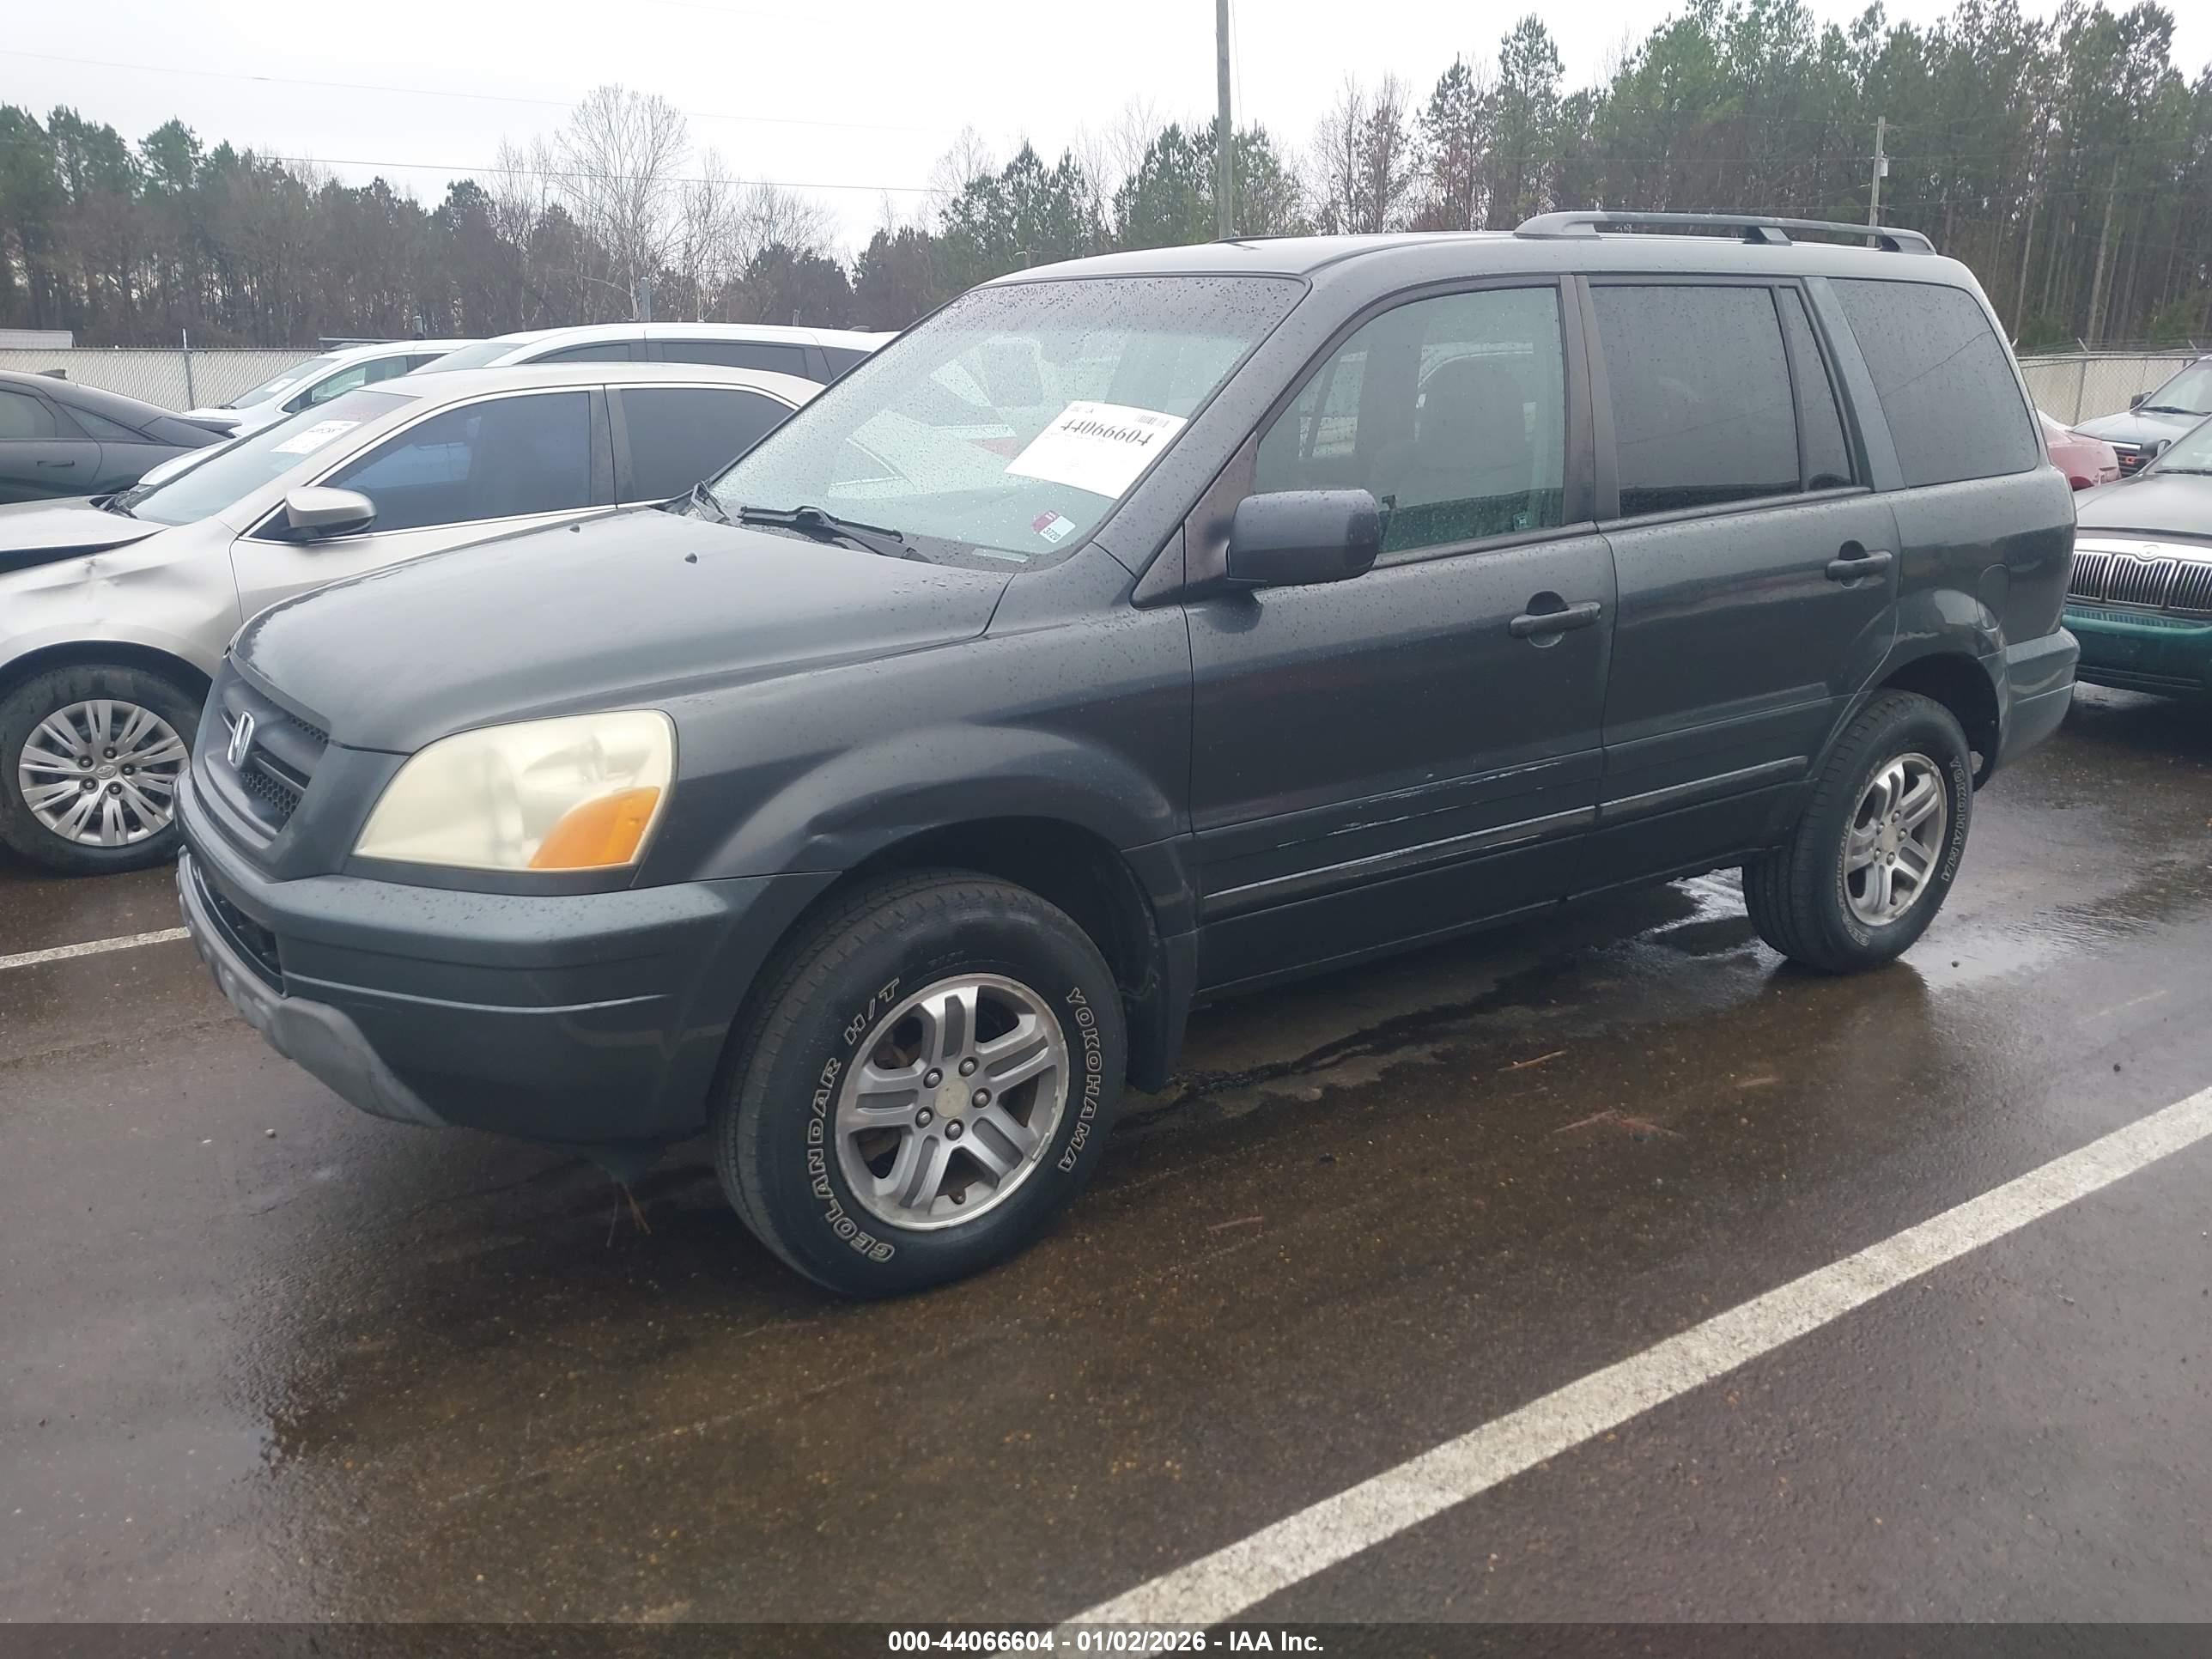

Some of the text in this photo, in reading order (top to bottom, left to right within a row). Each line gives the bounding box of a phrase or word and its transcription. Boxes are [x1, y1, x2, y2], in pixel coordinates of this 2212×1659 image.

[1060, 418, 1154, 446] 44066604
[807, 977, 902, 1263] GEOLANDAR H/T
[1057, 988, 1102, 1172] YOKOHAMA
